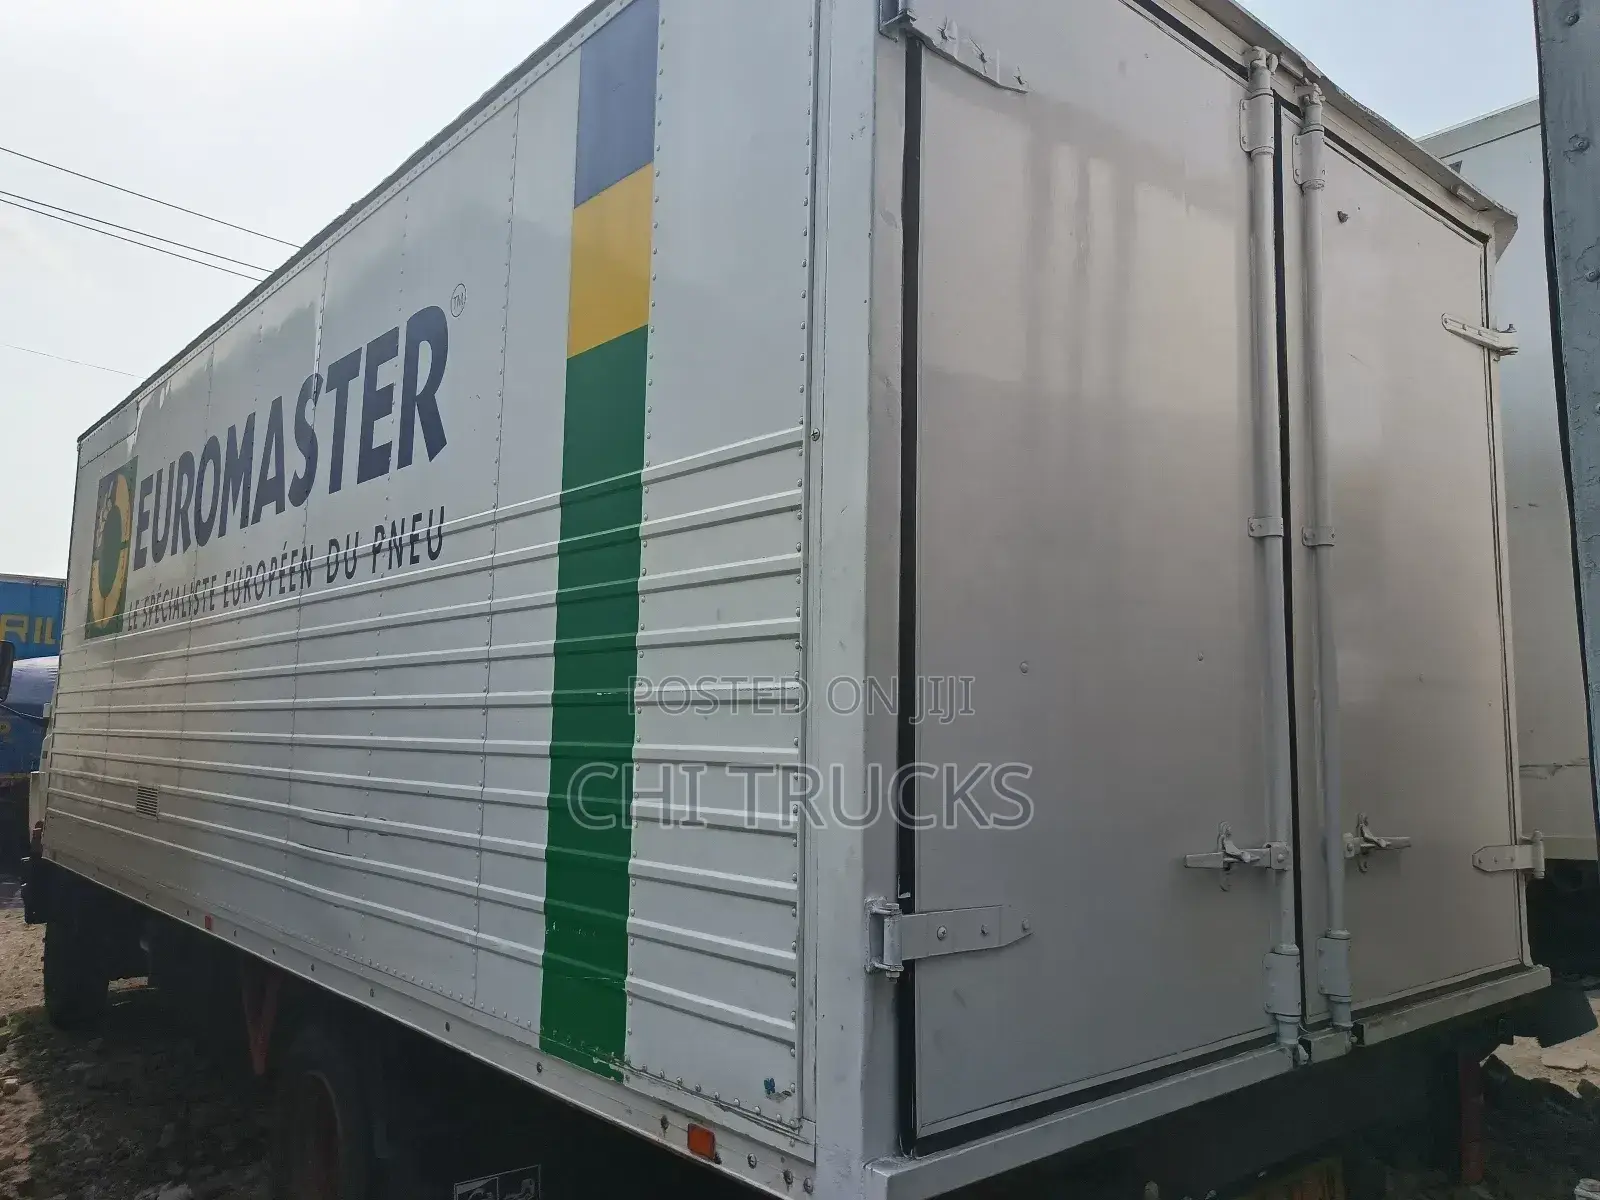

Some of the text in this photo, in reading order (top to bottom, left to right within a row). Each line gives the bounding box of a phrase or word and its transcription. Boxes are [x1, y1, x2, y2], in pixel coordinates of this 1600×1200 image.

[133, 305, 448, 572] EUROMASTER
[128, 506, 446, 632] LE SPÉCIALISTE EUROPÉEN DU PNEU
